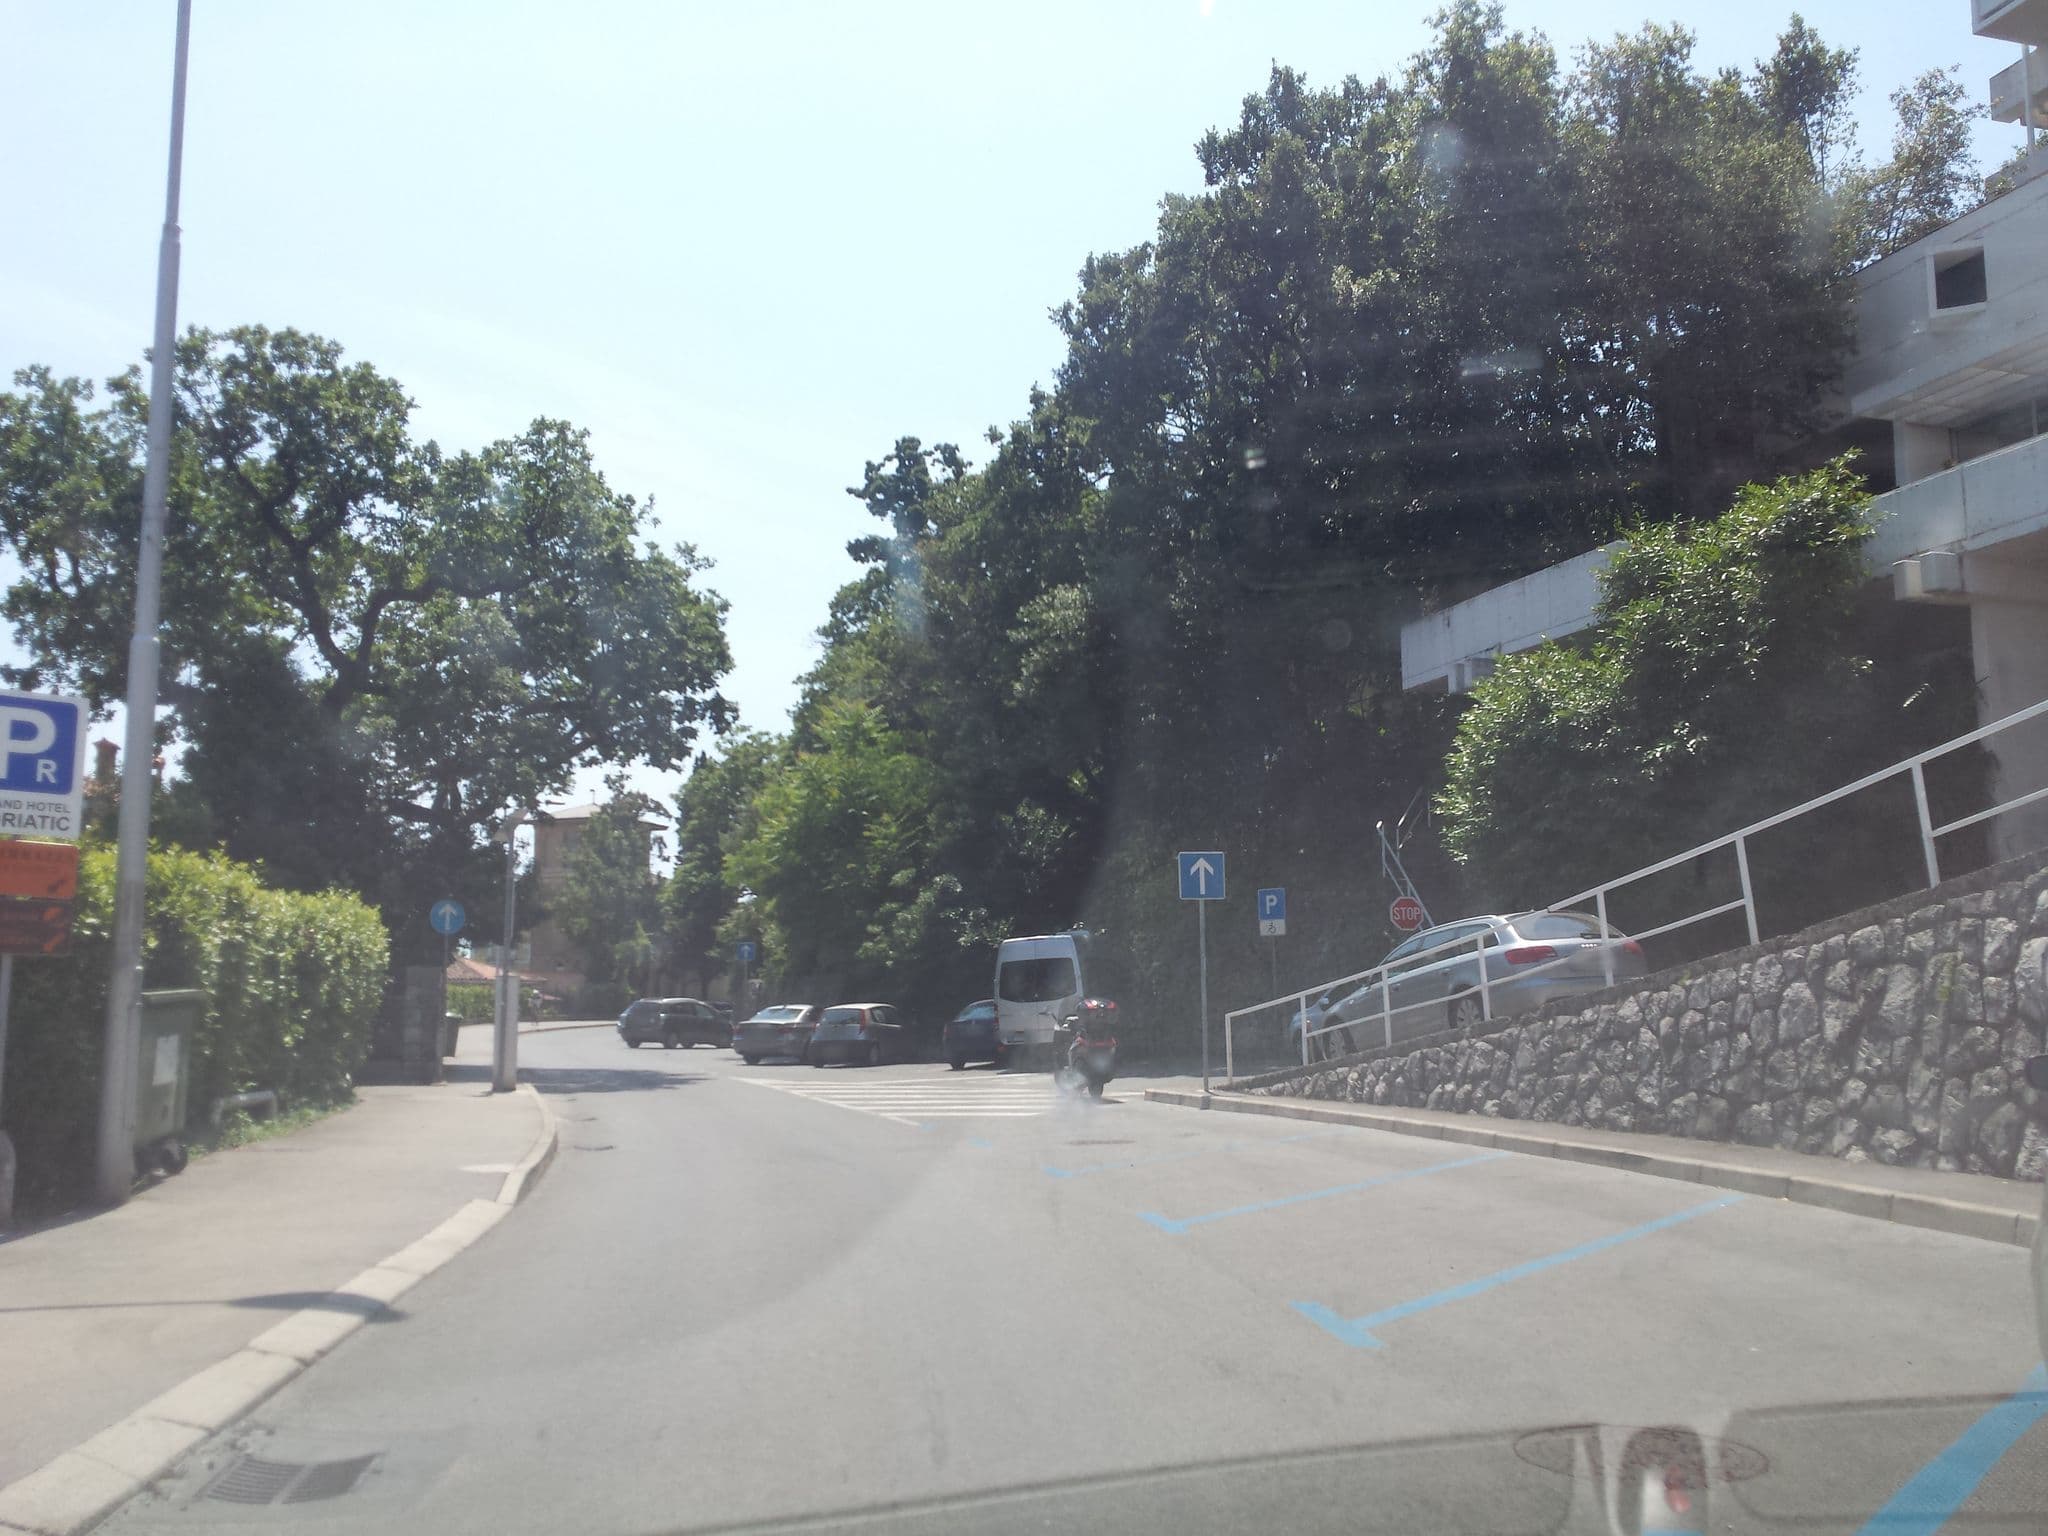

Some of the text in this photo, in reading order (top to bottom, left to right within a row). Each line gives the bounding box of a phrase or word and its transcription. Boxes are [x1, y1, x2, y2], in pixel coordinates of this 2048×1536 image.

[0, 706, 56, 779] P
[36, 759, 57, 784] R
[27, 801, 70, 813] HOTEL
[0, 812, 71, 831] RIATIC
[1265, 895, 1278, 914] P
[1393, 907, 1421, 920] STOP
